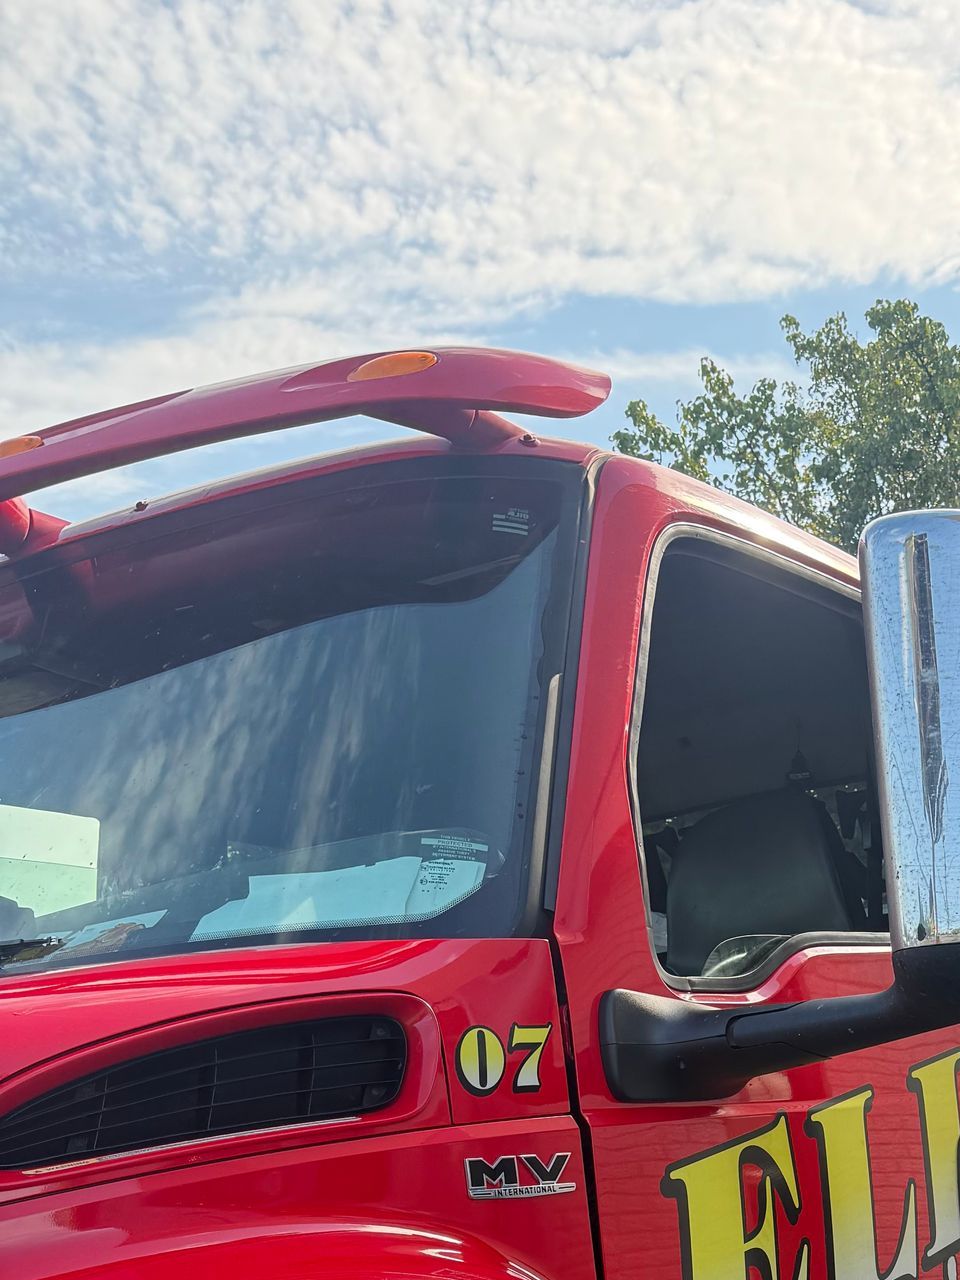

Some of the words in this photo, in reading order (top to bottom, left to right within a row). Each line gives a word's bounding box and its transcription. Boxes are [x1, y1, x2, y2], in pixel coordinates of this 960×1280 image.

[455, 1022, 553, 1097] 07
[464, 1152, 572, 1191] MV
[493, 1184, 558, 1199] INTERNATIONAL
